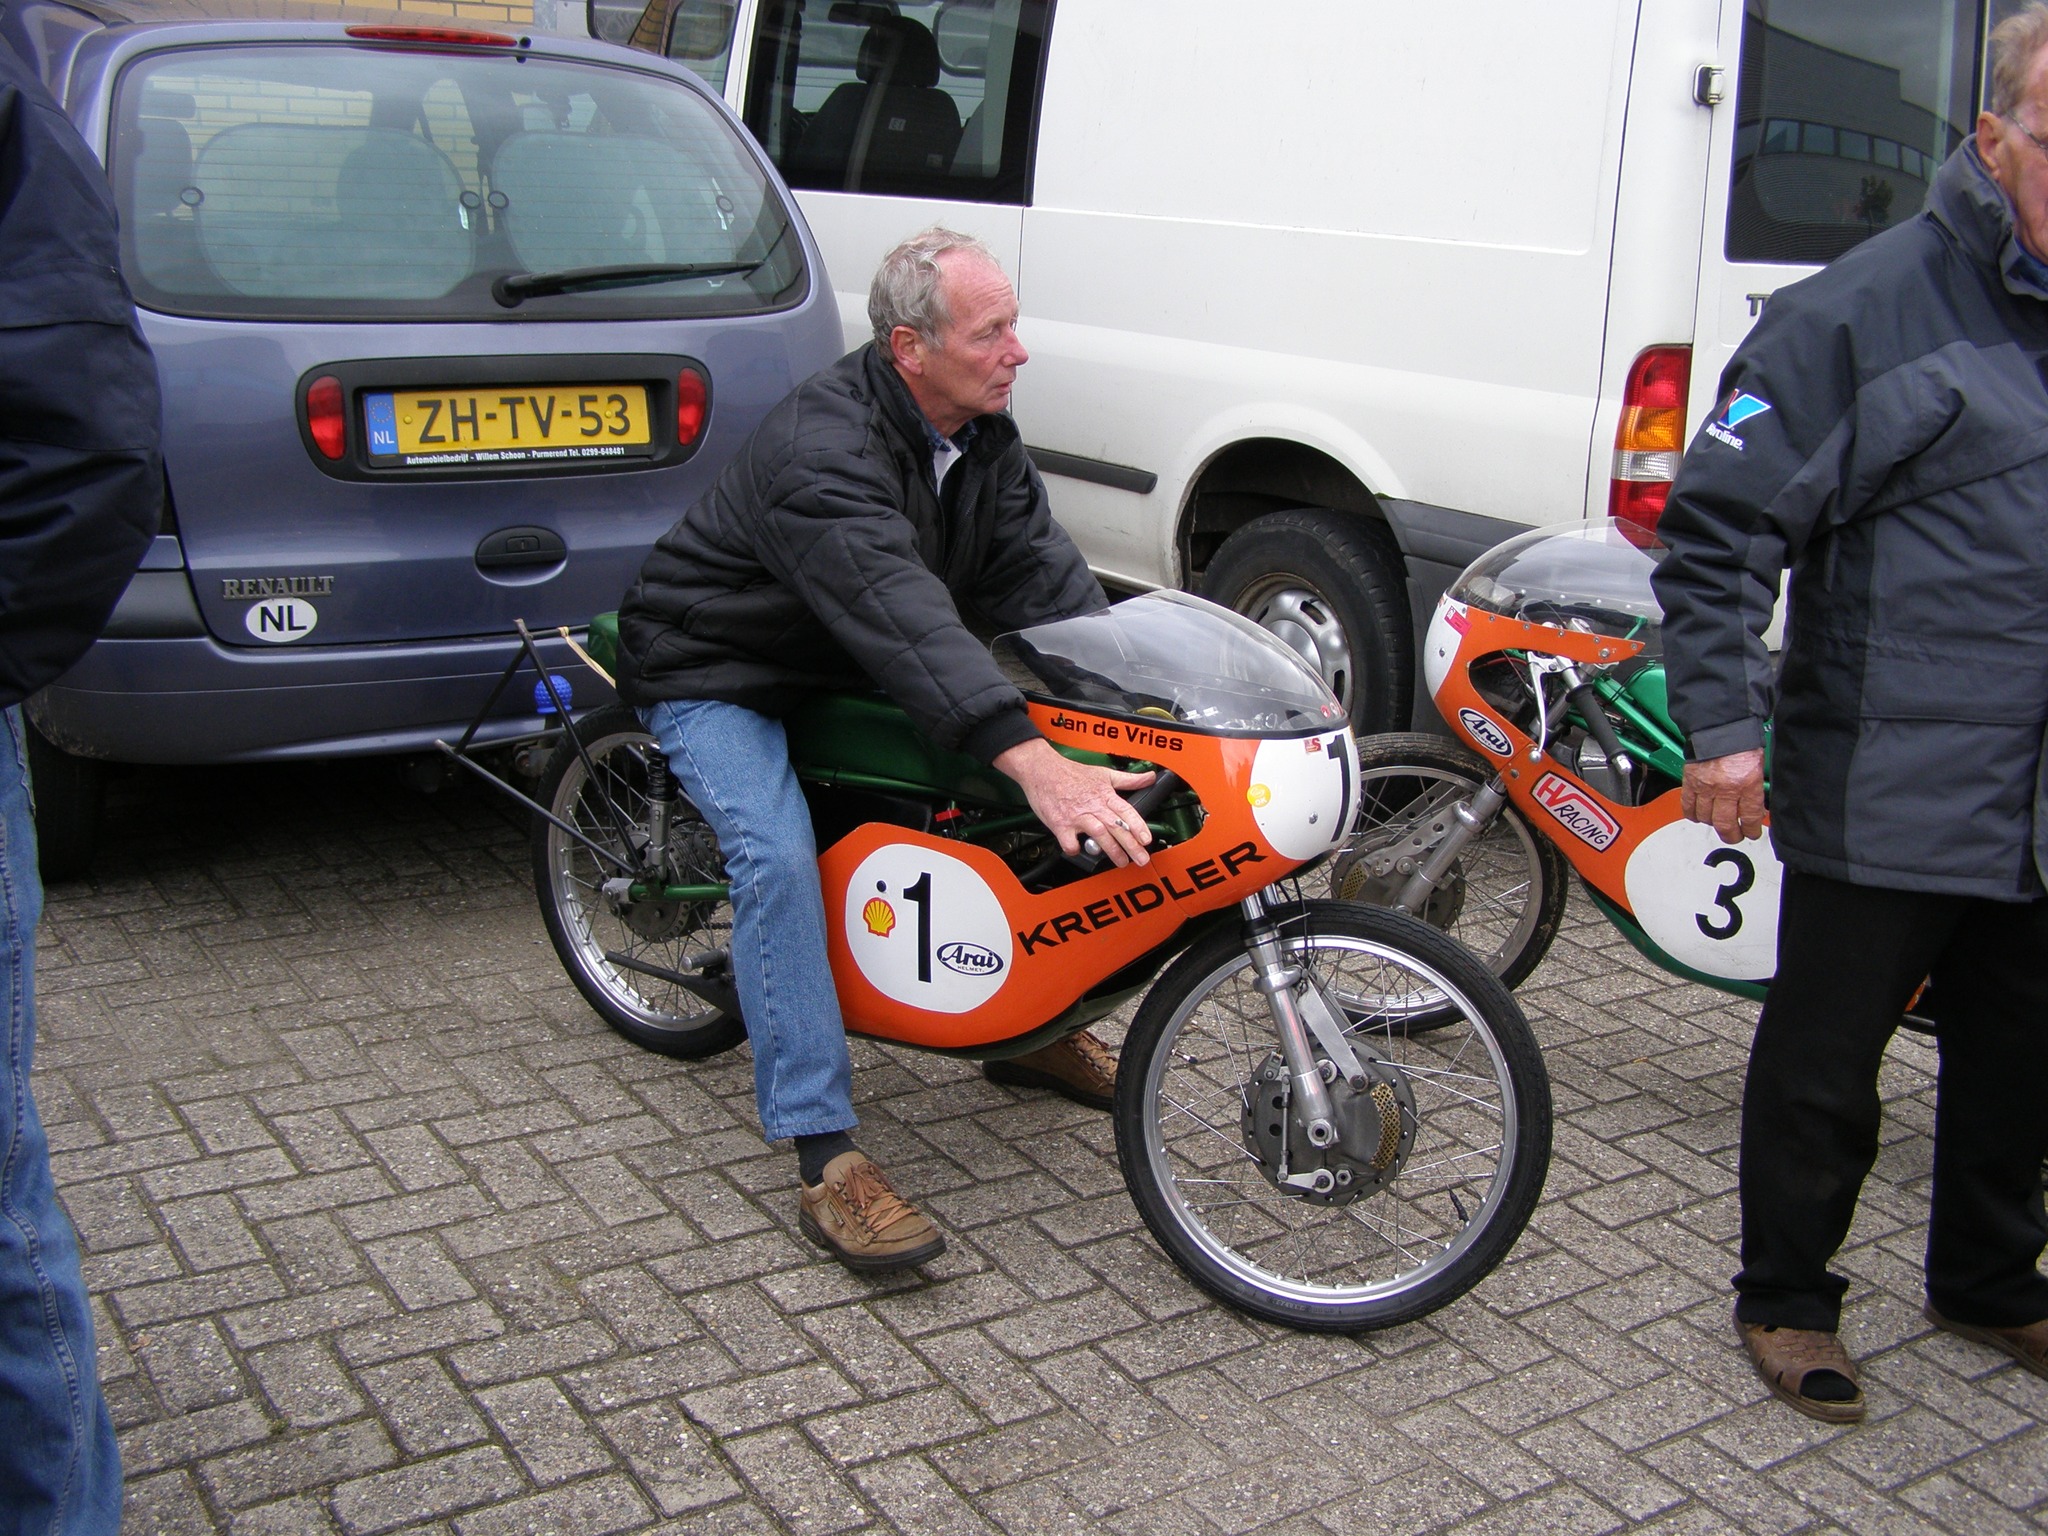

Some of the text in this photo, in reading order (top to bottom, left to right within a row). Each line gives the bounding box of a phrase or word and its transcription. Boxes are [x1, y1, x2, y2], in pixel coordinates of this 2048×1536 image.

[373, 430, 395, 445] NL
[417, 394, 631, 444] ZH-TV-53
[406, 453, 469, 465] Automobielbedrijf
[475, 452, 500, 461] Willem
[500, 450, 526, 460] Schoon
[531, 449, 568, 459] Purmerend
[568, 448, 581, 457] Tel.
[222, 575, 335, 600] RENAULT
[260, 604, 308, 633] NL
[1050, 712, 1184, 752] Jan de Vries
[1462, 716, 1508, 750] Arai
[1326, 733, 1351, 843] 1
[1553, 804, 1609, 845] RACING
[1016, 840, 1269, 957] KREIDLER
[1695, 847, 1756, 941] 3
[903, 871, 931, 984] 1
[941, 945, 995, 969] Arai
